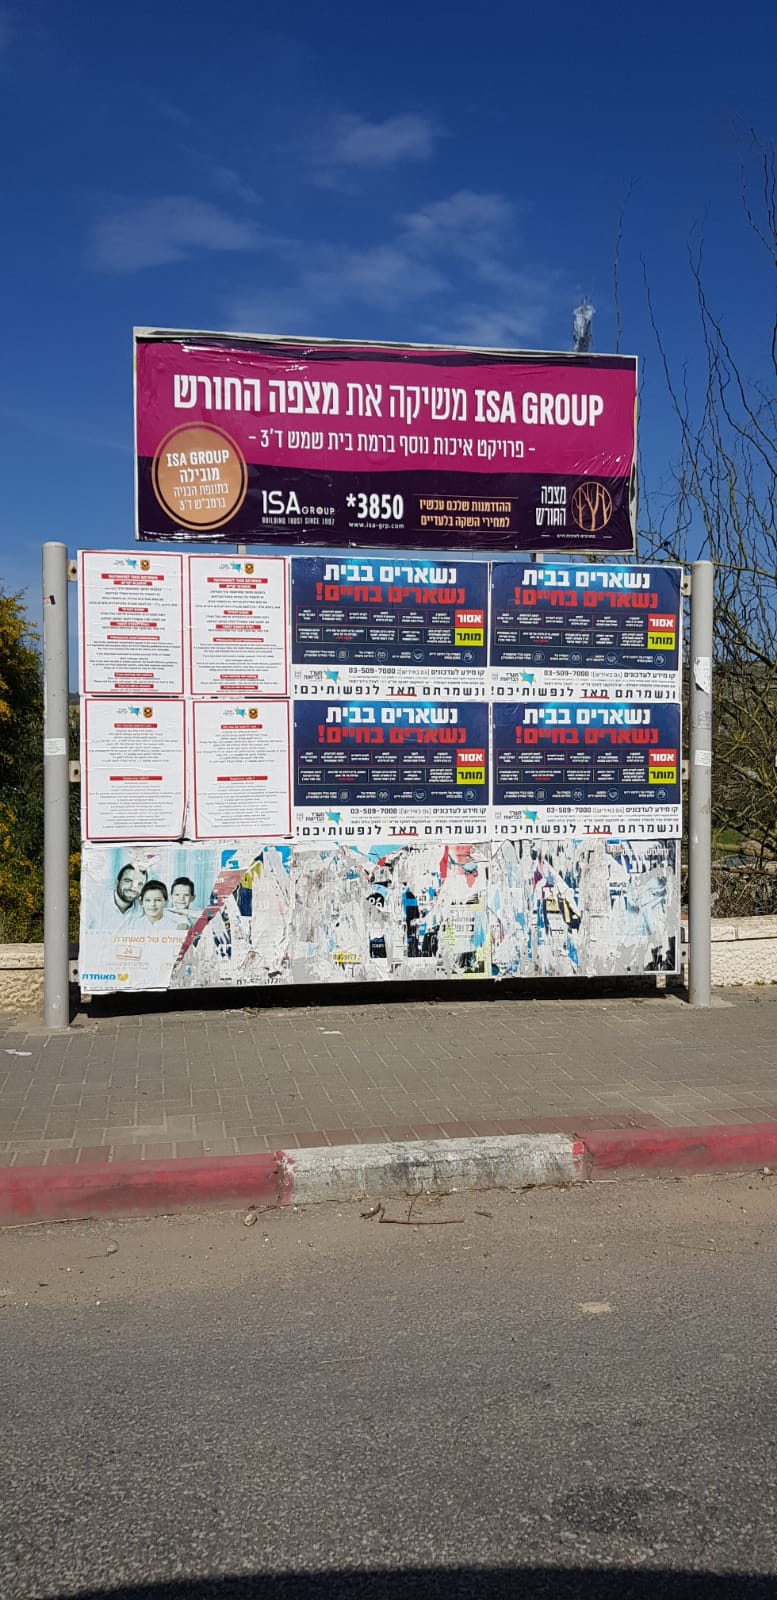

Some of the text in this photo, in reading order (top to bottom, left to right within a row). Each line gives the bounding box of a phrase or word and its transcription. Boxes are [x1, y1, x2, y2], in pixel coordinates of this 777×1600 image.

[174, 374, 604, 426] ISA GROUP משיקה את מצפה החורש
[288, 430, 324, 450] שמש
[328, 432, 353, 452] בית
[357, 434, 396, 453] ברמת
[400, 435, 429, 457] נוסף
[433, 436, 473, 457] איכות
[478, 440, 524, 460] פרויקט
[166, 450, 230, 468] ISA GROUP
[180, 467, 220, 483] מובילה
[174, 485, 198, 498] הבניה
[542, 486, 566, 504] מצפה
[262, 490, 335, 515] ISA GROUP
[420, 499, 512, 512] ההזדמנות שלכם עכשיו
[420, 515, 510, 528] למחירי השקה בלעדיים
[536, 508, 566, 526] החורש
[348, 522, 404, 530] www.isa-grp.com
[324, 564, 456, 584] נשארים בבית
[522, 569, 650, 588] נשארים בבית
[316, 582, 466, 604] נשארים בחיים!
[514, 586, 658, 608] נשארים בחיים!
[456, 614, 482, 624] אסור
[650, 618, 674, 628] אסור
[456, 632, 482, 640] מותר
[650, 636, 672, 645] מותר
[431, 668, 460, 676] לעדכונים
[294, 684, 485, 696] ונשמרתם מאד לנפשותיכם!
[491, 686, 676, 699] ונשמרתם מאד לנפשותיכם!
[326, 706, 458, 724] נשארים בבית
[522, 708, 650, 725] נשארים בבית
[318, 725, 466, 744] נשארים בחיים!
[516, 726, 659, 744] נשארים בחיים!
[458, 754, 482, 762] אסור
[650, 754, 674, 762] אסור
[458, 772, 482, 780] מותר
[296, 824, 486, 836] ונשמרתם מאד לנפשותיכם!
[495, 824, 679, 834] ונשמרתם מאד לנפשותיכם!
